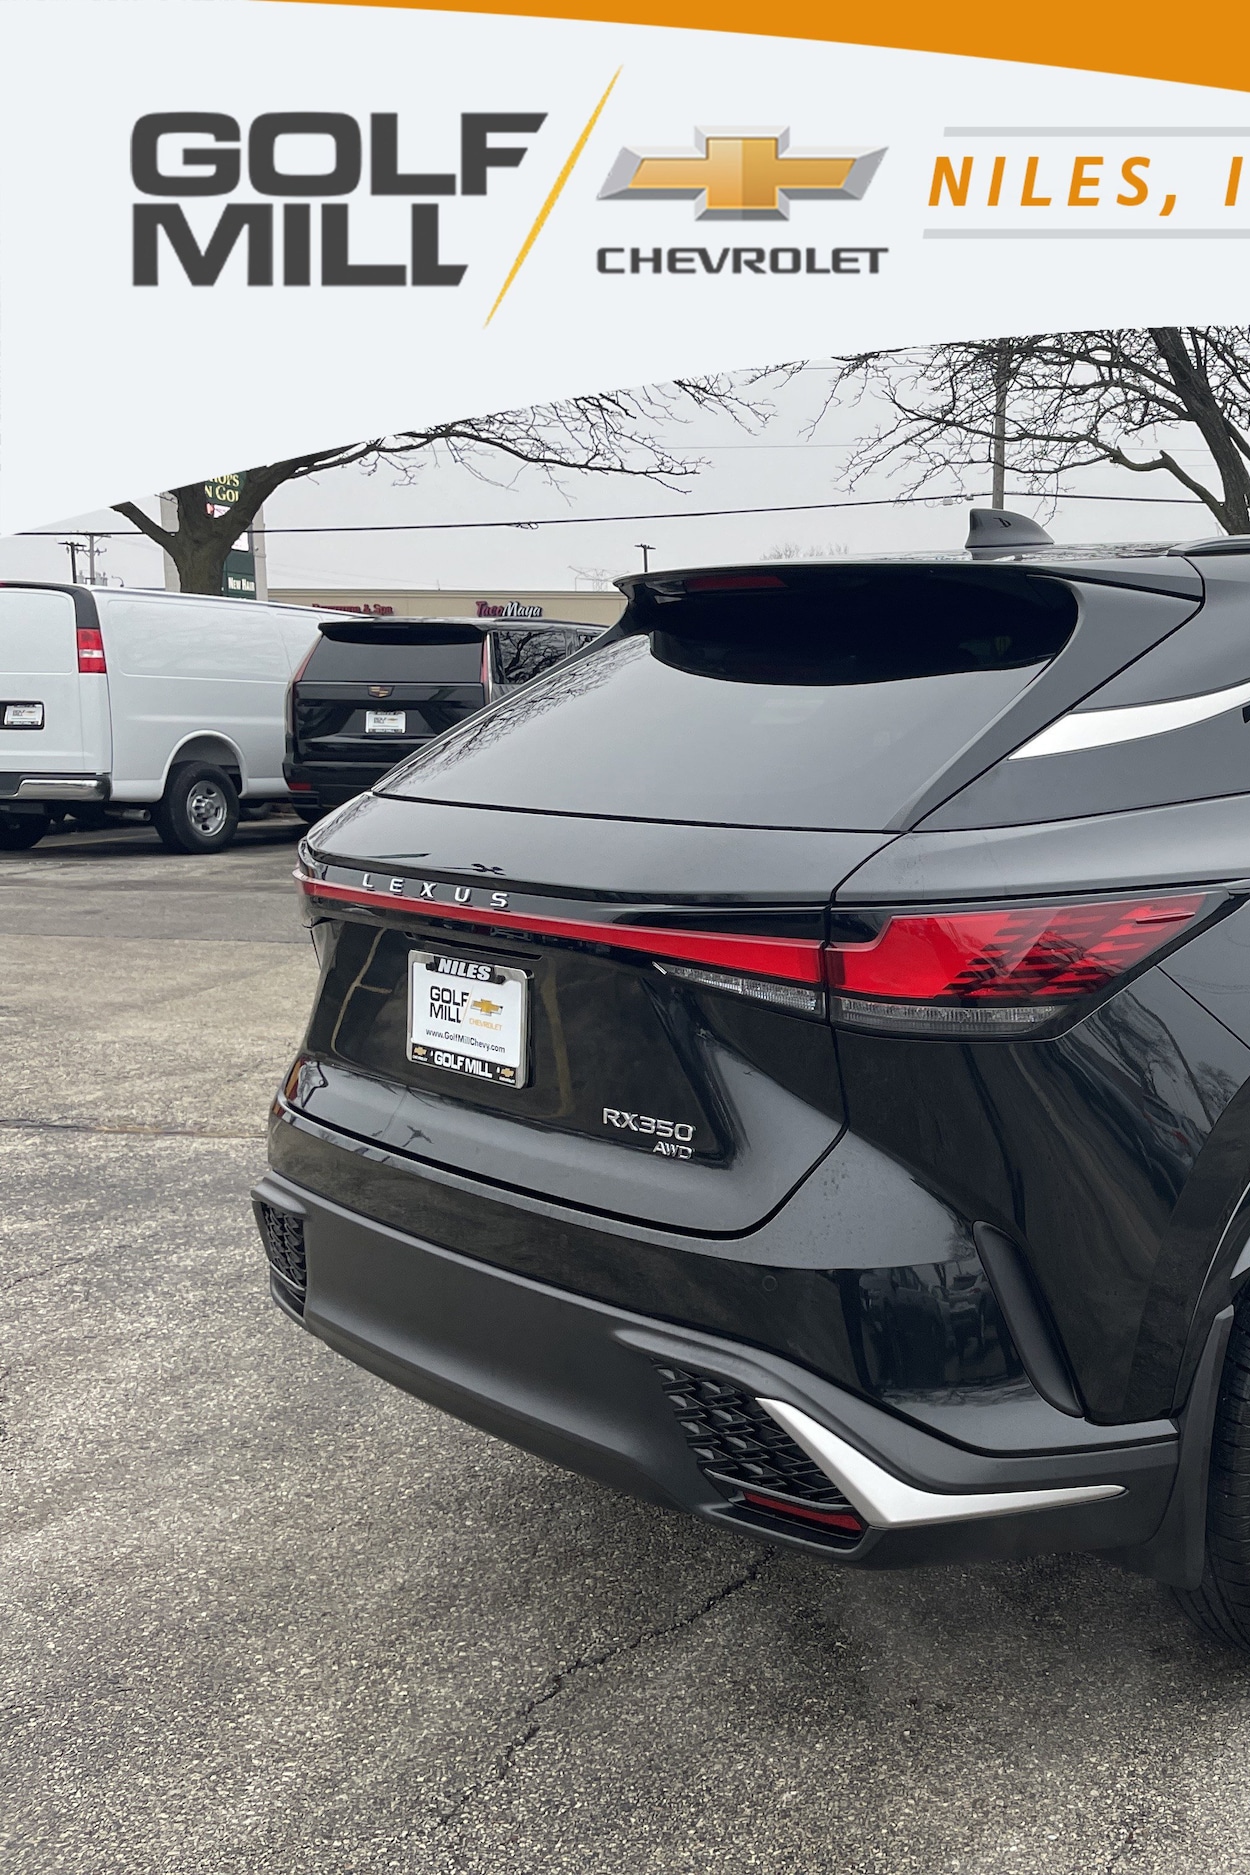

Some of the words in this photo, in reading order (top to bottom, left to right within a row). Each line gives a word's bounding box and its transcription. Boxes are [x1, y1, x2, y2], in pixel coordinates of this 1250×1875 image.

[362, 873, 509, 908] LEXUS
[437, 958, 492, 981] NILES
[430, 985, 470, 1008] GOLF
[429, 1002, 462, 1024] MILL
[425, 1028, 506, 1054] www.GolfMillChevy.com
[434, 1050, 465, 1071] GOLF
[465, 1058, 493, 1079] MILL
[602, 1107, 694, 1142] RX350
[652, 1141, 694, 1160] AWD
